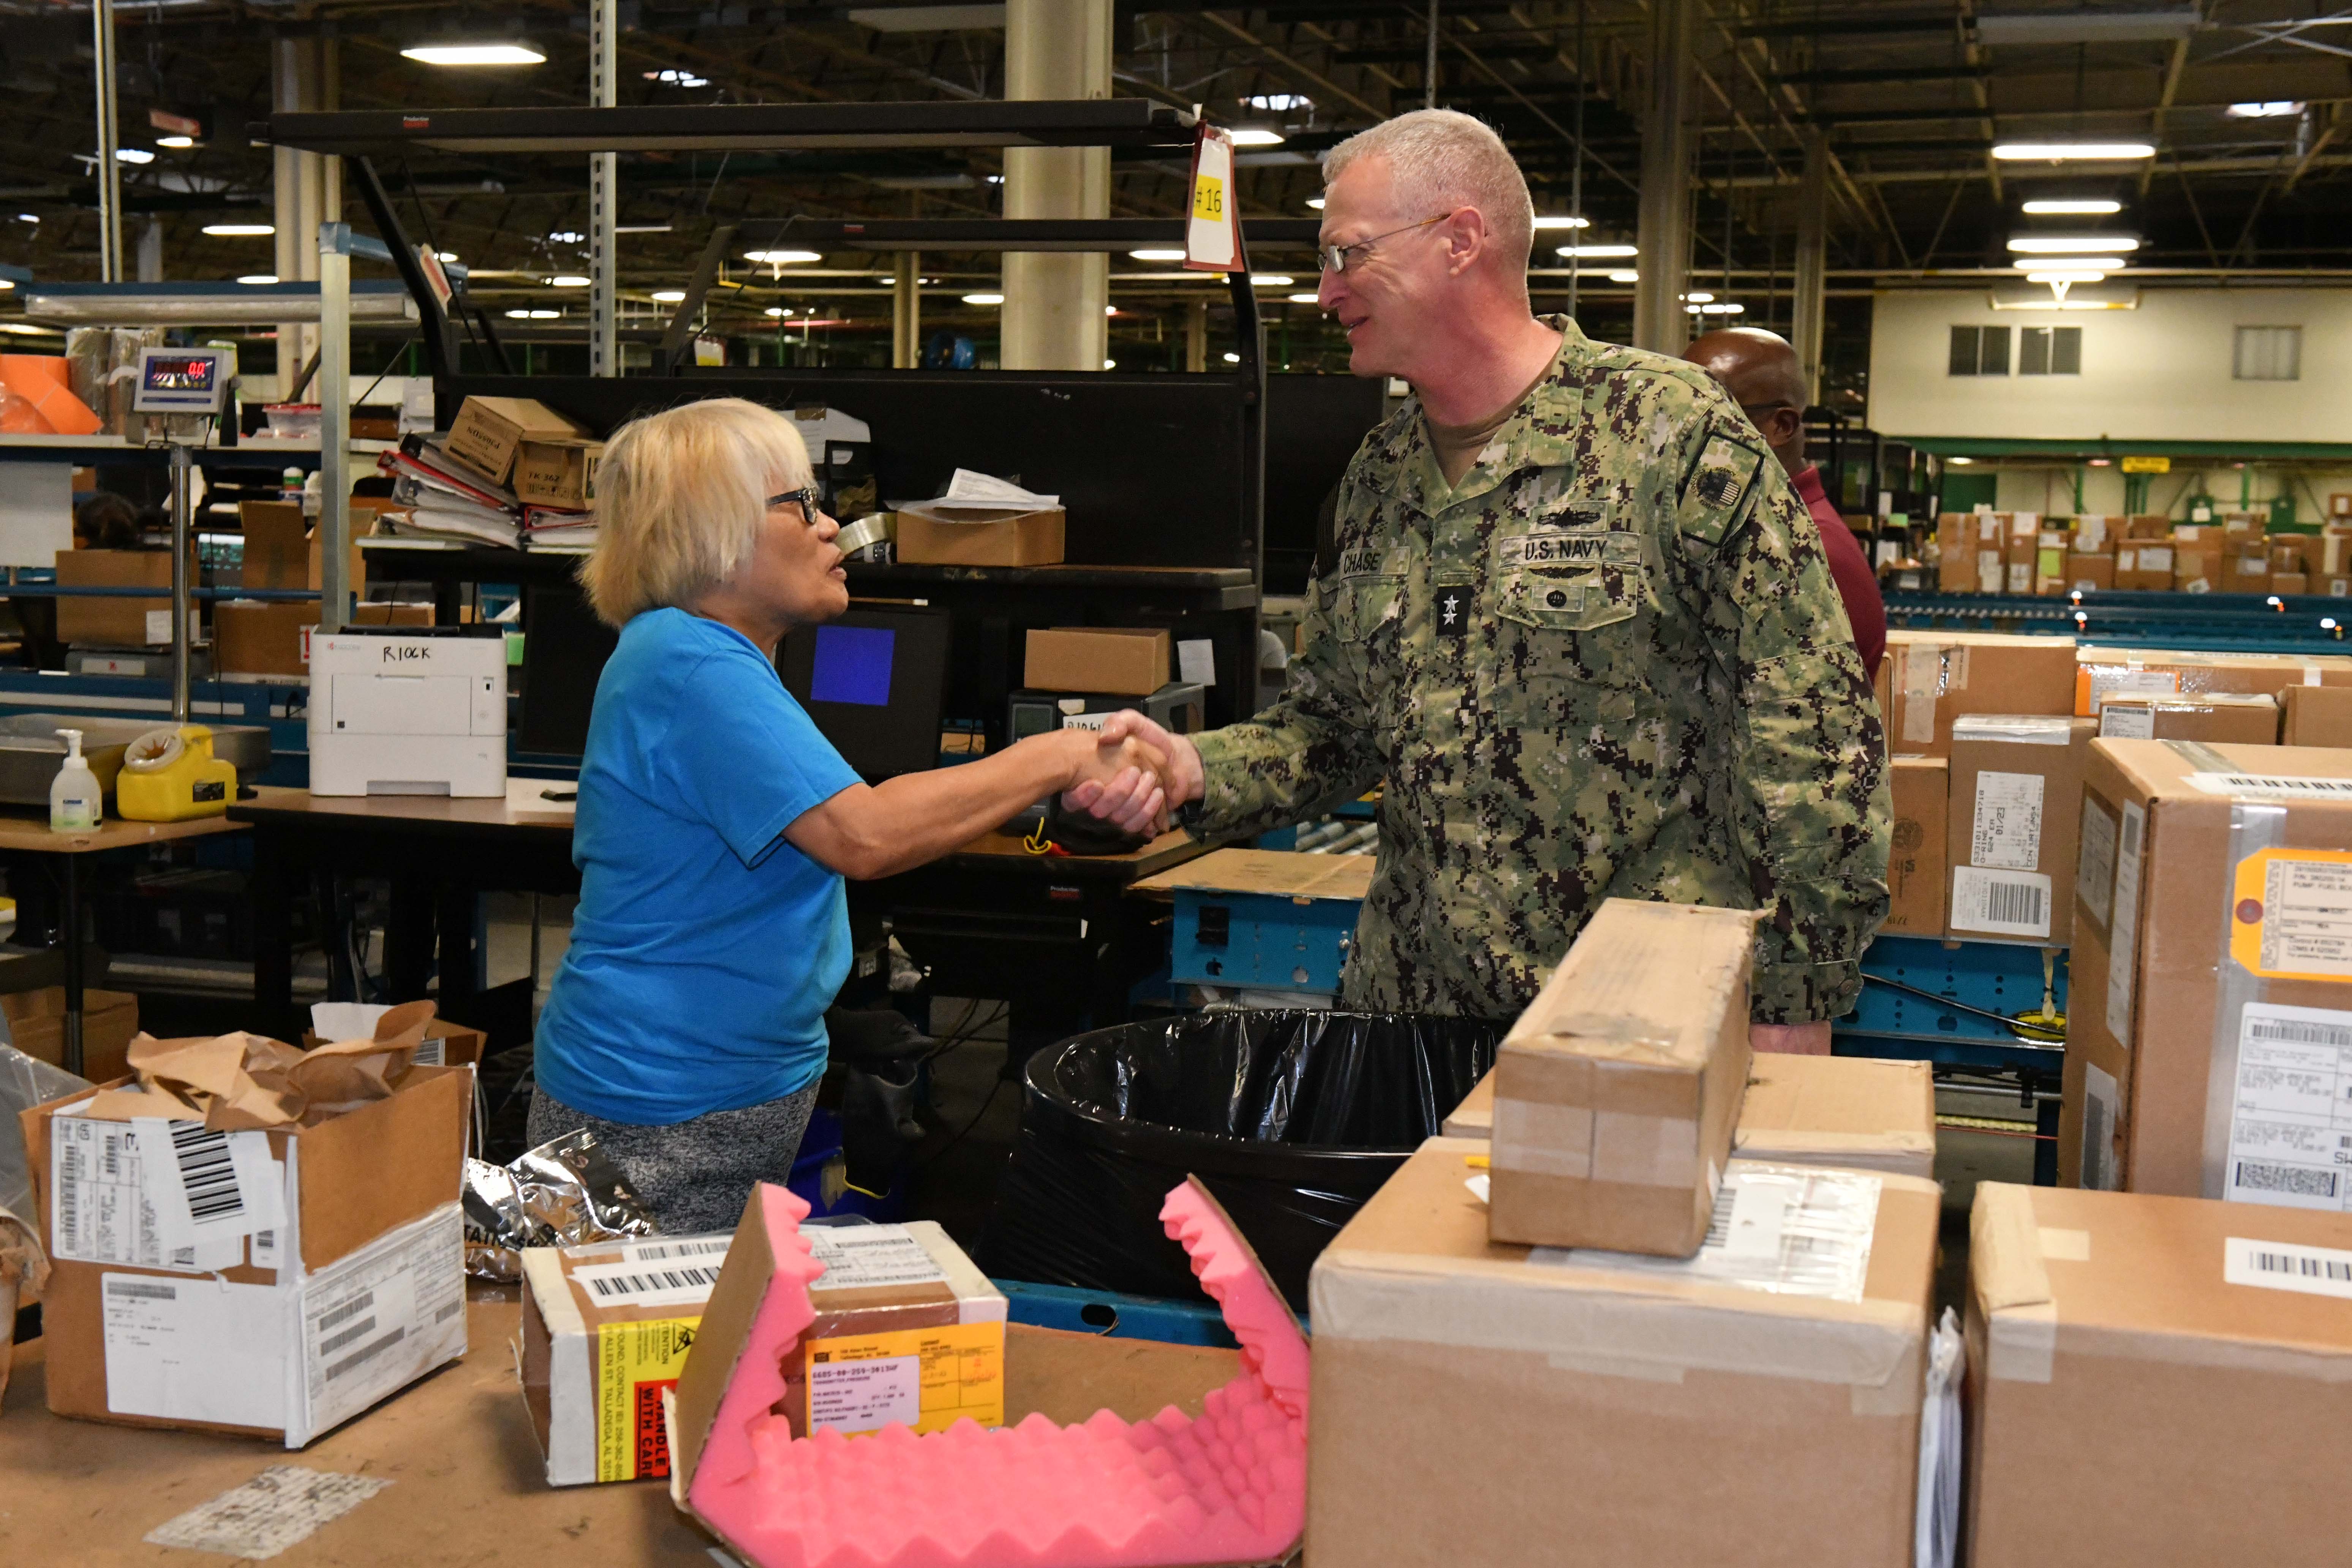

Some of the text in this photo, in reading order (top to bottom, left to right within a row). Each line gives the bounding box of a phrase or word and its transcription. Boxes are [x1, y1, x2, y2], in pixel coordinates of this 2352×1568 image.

[1525, 540, 1608, 560] U.S. NAVY
[1344, 552, 1381, 574] CHASE
[1996, 807, 2005, 835] 01/23
[643, 1388, 653, 1429] WITH
